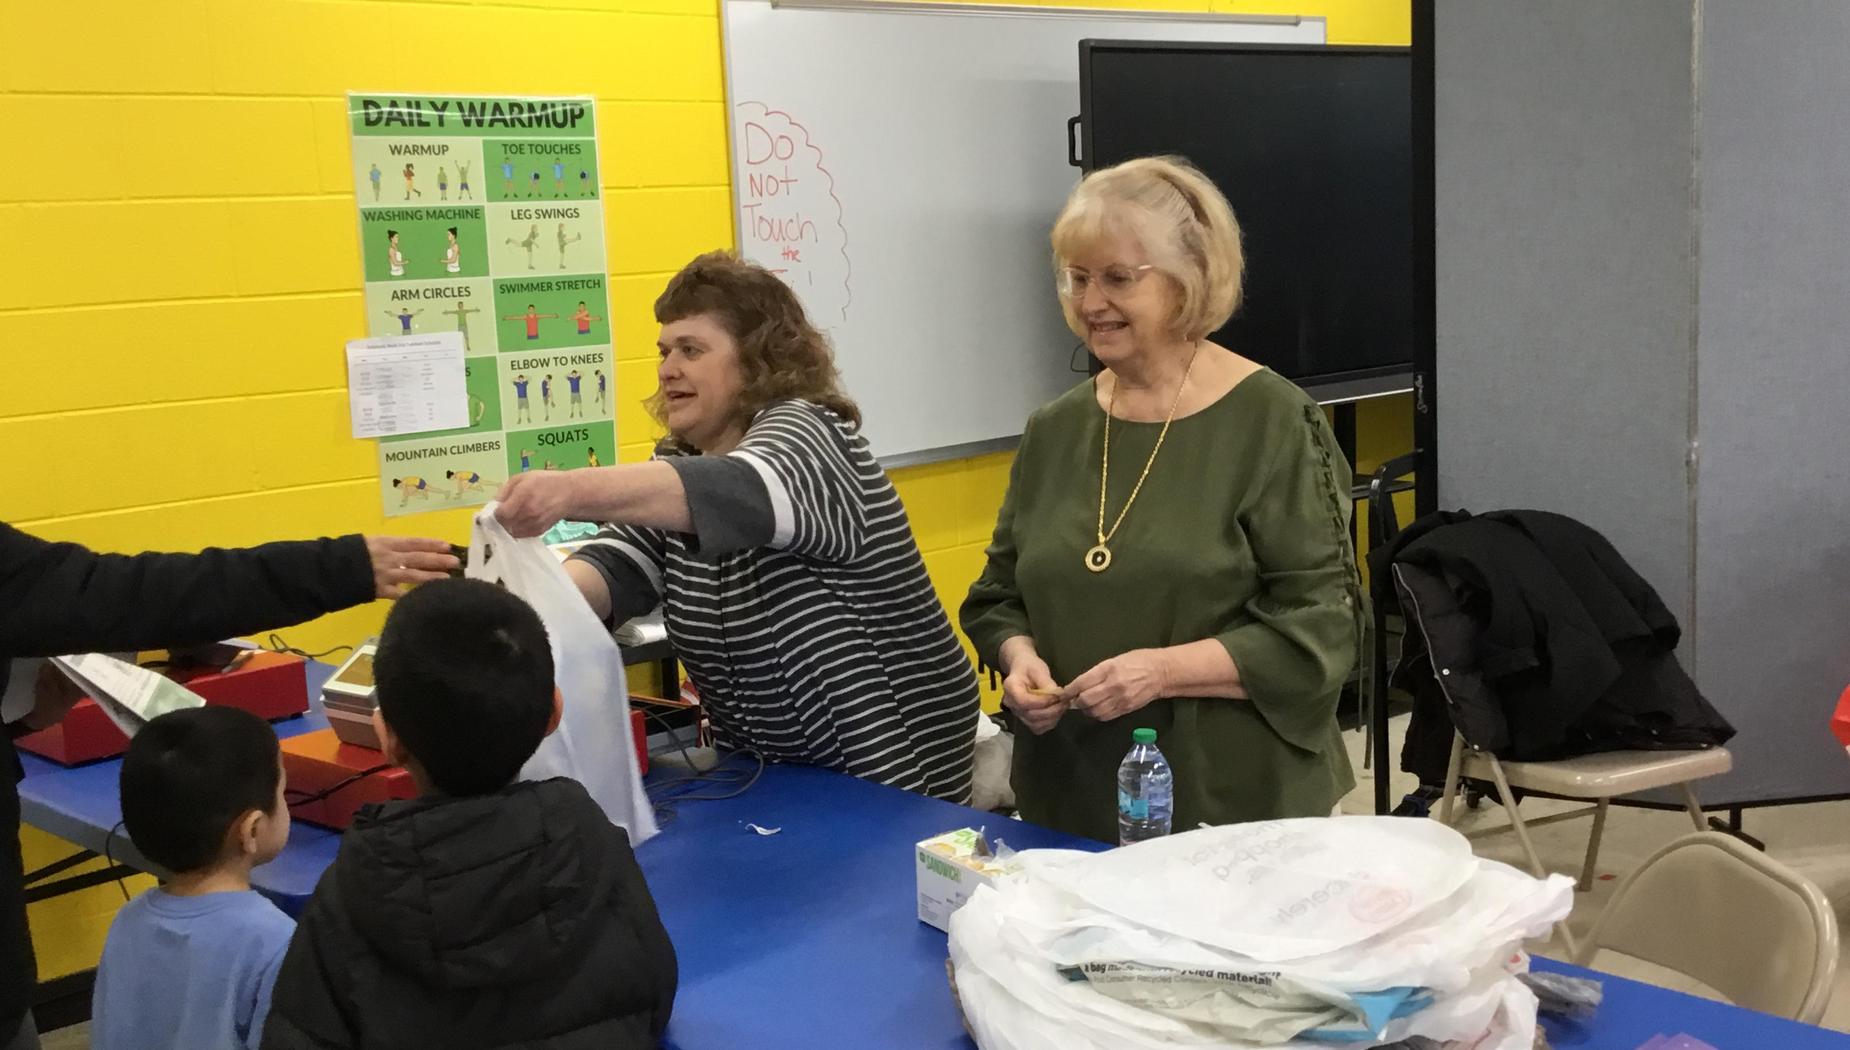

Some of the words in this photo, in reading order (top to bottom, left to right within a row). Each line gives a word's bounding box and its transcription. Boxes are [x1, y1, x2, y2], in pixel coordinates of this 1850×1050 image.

[362, 99, 449, 127] DAILY
[456, 101, 585, 129] WARMUP
[389, 144, 449, 156] WARMUP
[502, 143, 525, 154] TOE
[528, 143, 582, 155] TOUCHES
[744, 121, 794, 164] Do
[363, 208, 424, 222] WASHING
[426, 208, 481, 221] MACHINE
[511, 209, 532, 220] LEG
[535, 207, 580, 219] SWINGS
[742, 202, 818, 243] Touch
[781, 245, 802, 263] the
[391, 288, 421, 301] ARM
[423, 286, 472, 299] CIRCLES
[499, 280, 553, 294] SWIMMER
[555, 278, 601, 291] STRETCH
[510, 356, 551, 371] ELBOW
[553, 356, 569, 367] TO
[571, 352, 604, 365] KNEES
[537, 428, 589, 446] SQUATS
[385, 446, 448, 463] MOUNTAIN
[450, 440, 501, 456] CLIMBERS
[926, 854, 962, 882] SANDWICH
[1090, 962, 1106, 973] bag
